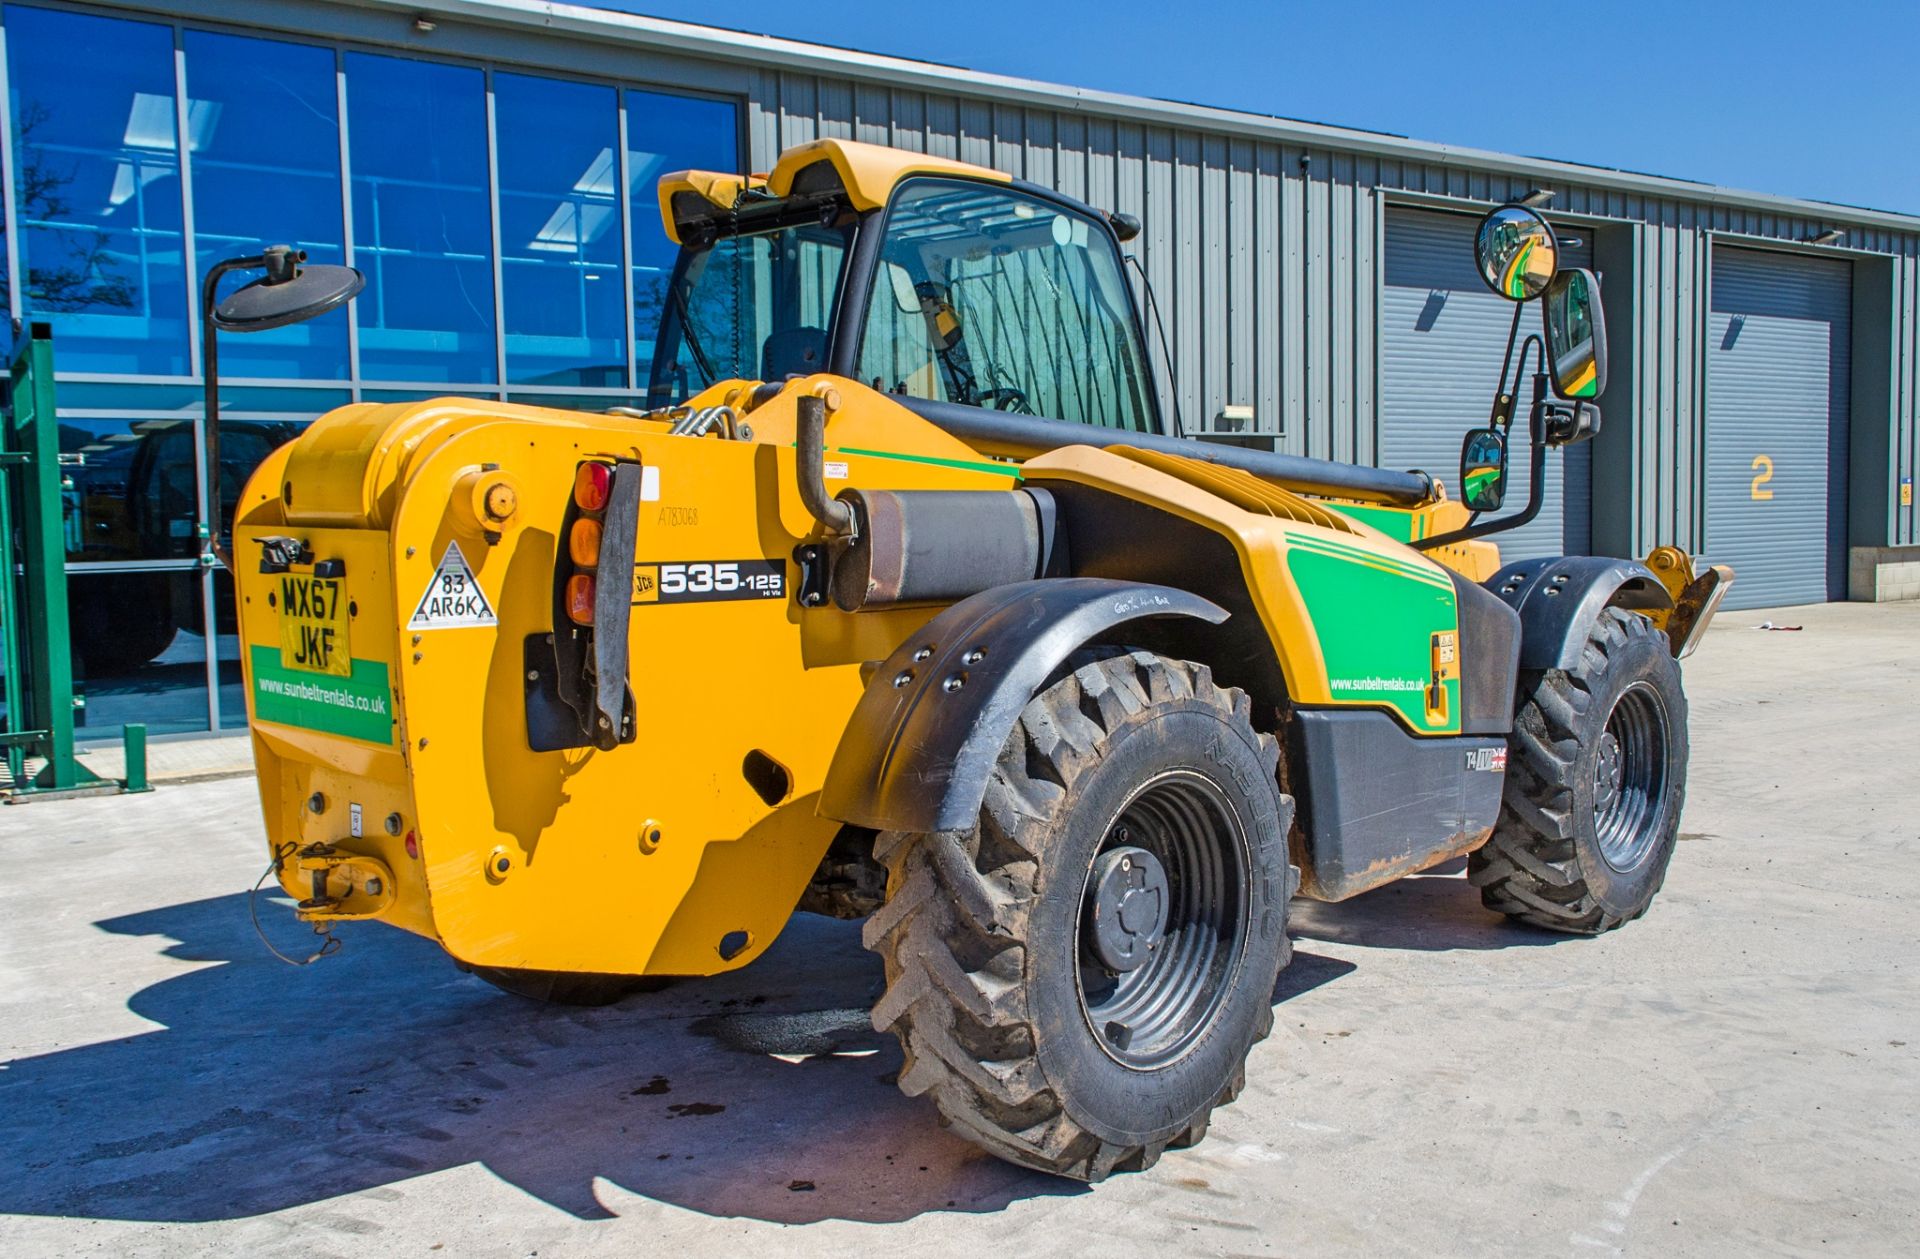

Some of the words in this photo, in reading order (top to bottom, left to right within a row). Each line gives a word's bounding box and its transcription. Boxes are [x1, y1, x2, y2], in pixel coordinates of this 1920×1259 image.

[1751, 454, 1774, 500] 2
[658, 506, 698, 527] A783068
[442, 574, 465, 594] 83
[636, 575, 653, 593] JCB
[282, 577, 339, 620] MX67
[430, 596, 478, 617] AR6K
[294, 625, 335, 667] JKF
[1331, 676, 1425, 691] www.sunbeltrentals.co.uk
[258, 678, 386, 715] www.sunbeltrentals.co.uk
